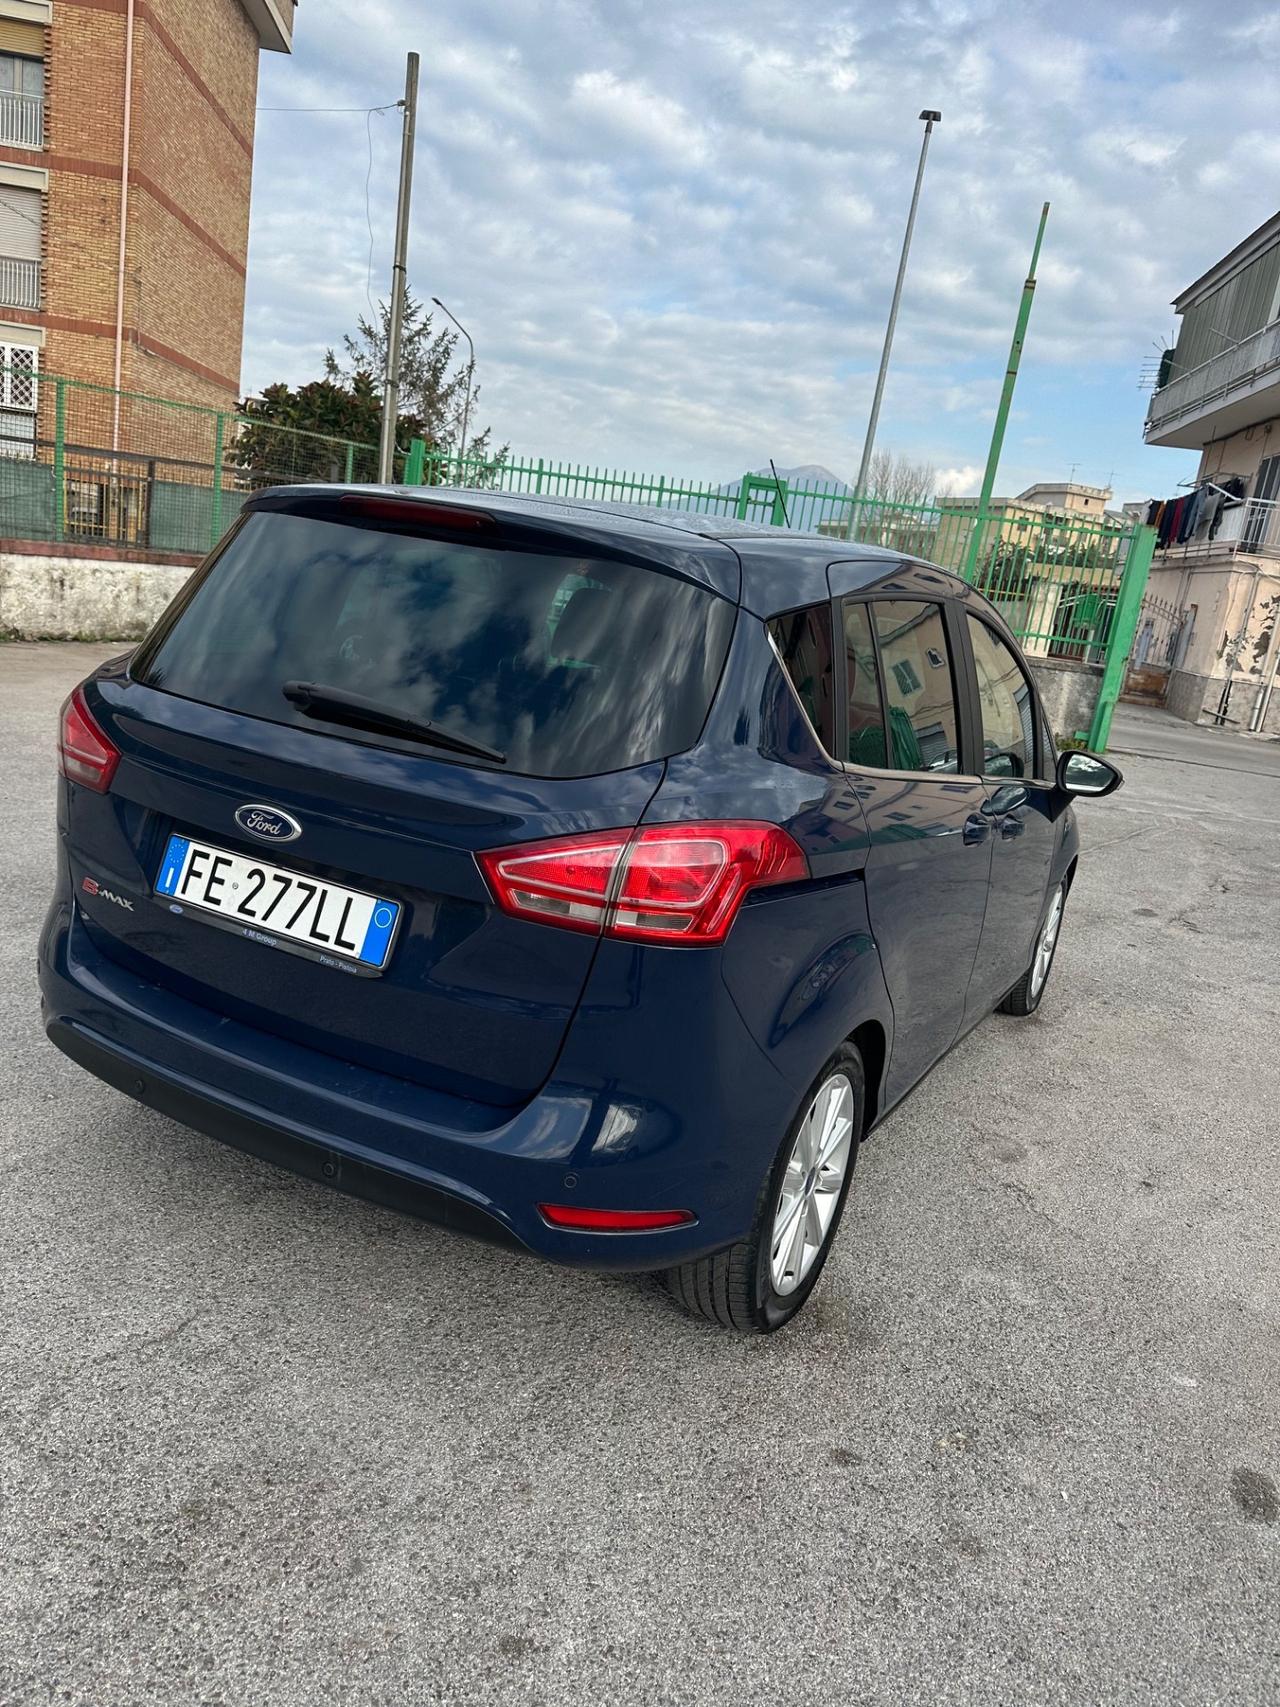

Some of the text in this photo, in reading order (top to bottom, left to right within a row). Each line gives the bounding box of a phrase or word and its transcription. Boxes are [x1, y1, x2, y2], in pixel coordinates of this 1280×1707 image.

[247, 811, 283, 835] Ford
[181, 849, 356, 951] FE 277LL
[256, 933, 277, 947] Group
